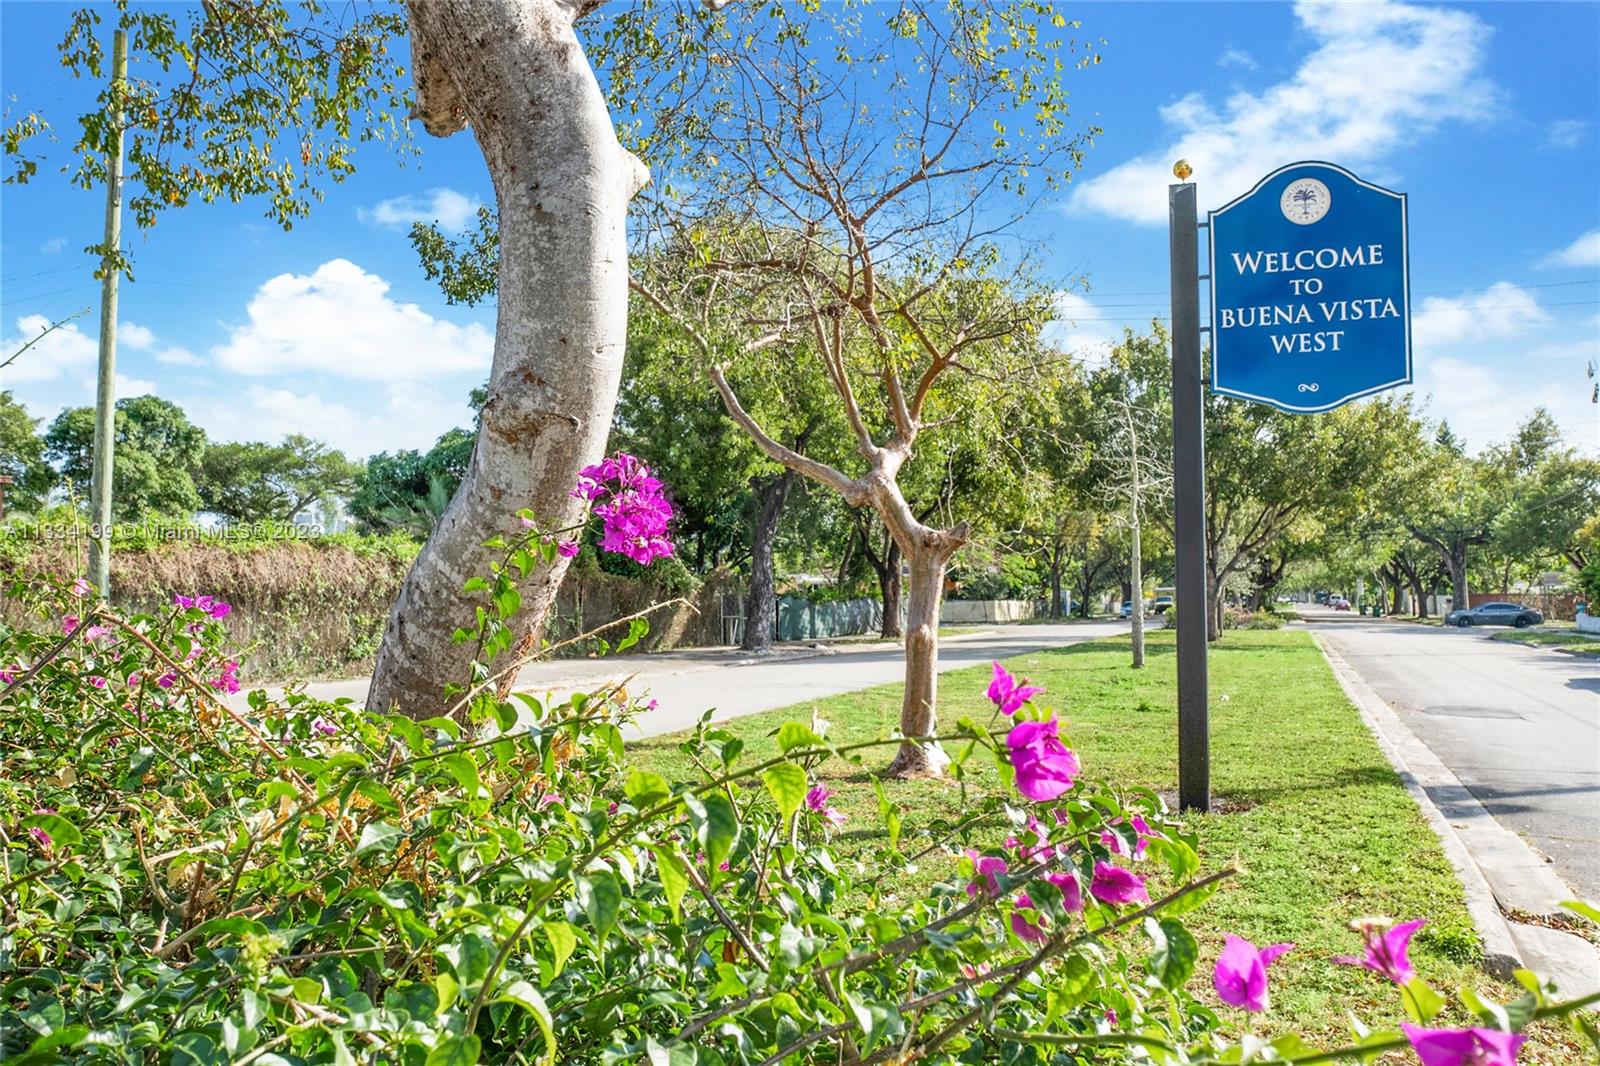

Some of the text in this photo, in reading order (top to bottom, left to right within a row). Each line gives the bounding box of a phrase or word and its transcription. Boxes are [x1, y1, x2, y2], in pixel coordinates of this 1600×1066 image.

[1231, 244, 1384, 275] WELCOME
[1289, 278, 1323, 296] TO
[1220, 297, 1401, 328] BUENA VISTA
[1270, 331, 1345, 354] WEST
